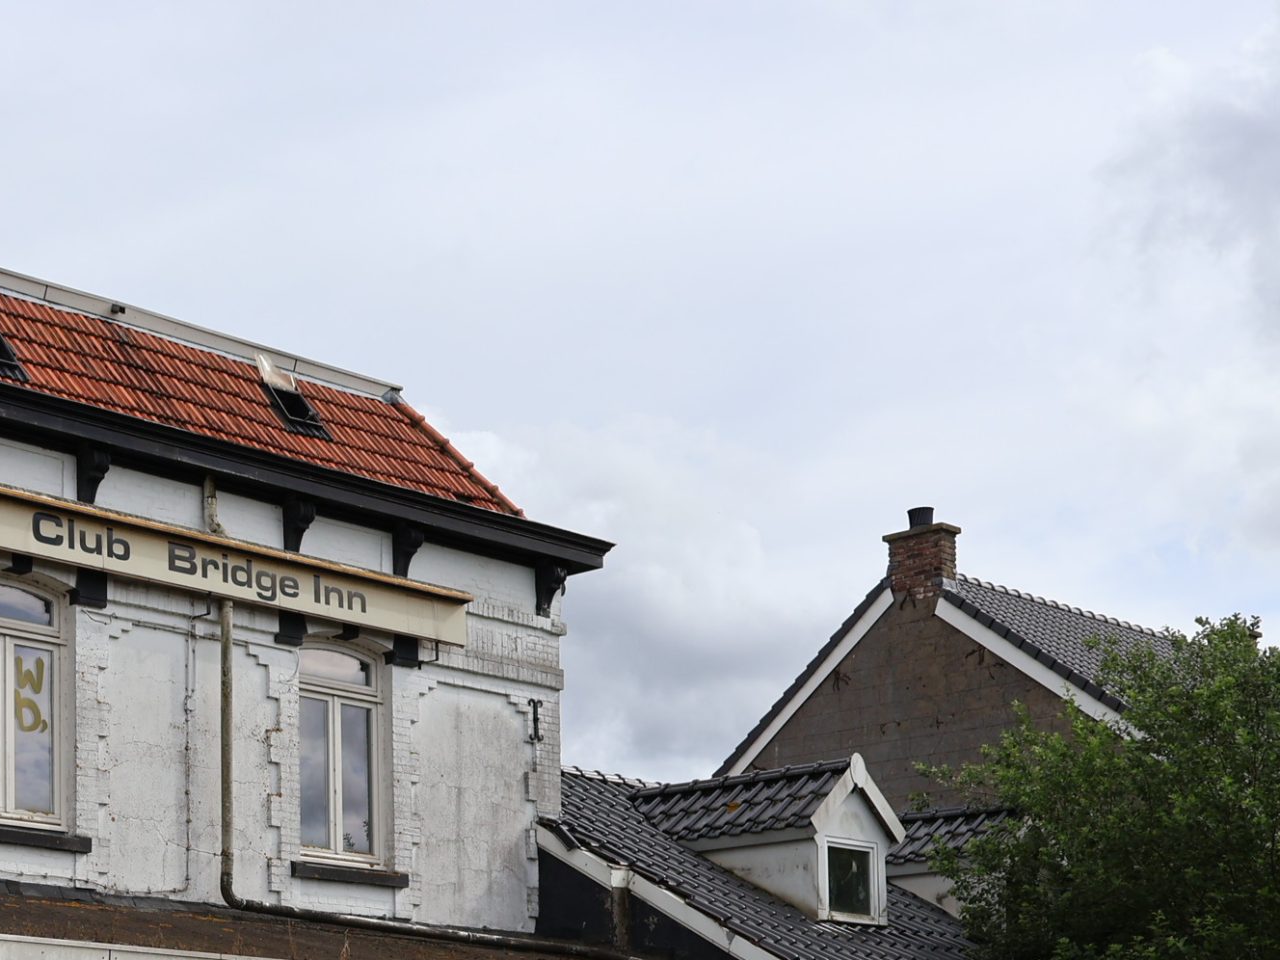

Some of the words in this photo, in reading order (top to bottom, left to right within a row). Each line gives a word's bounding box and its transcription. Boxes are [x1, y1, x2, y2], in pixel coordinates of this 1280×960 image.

[32, 511, 131, 561] Club
[168, 541, 300, 601] Bridge
[313, 574, 367, 613] Inn
